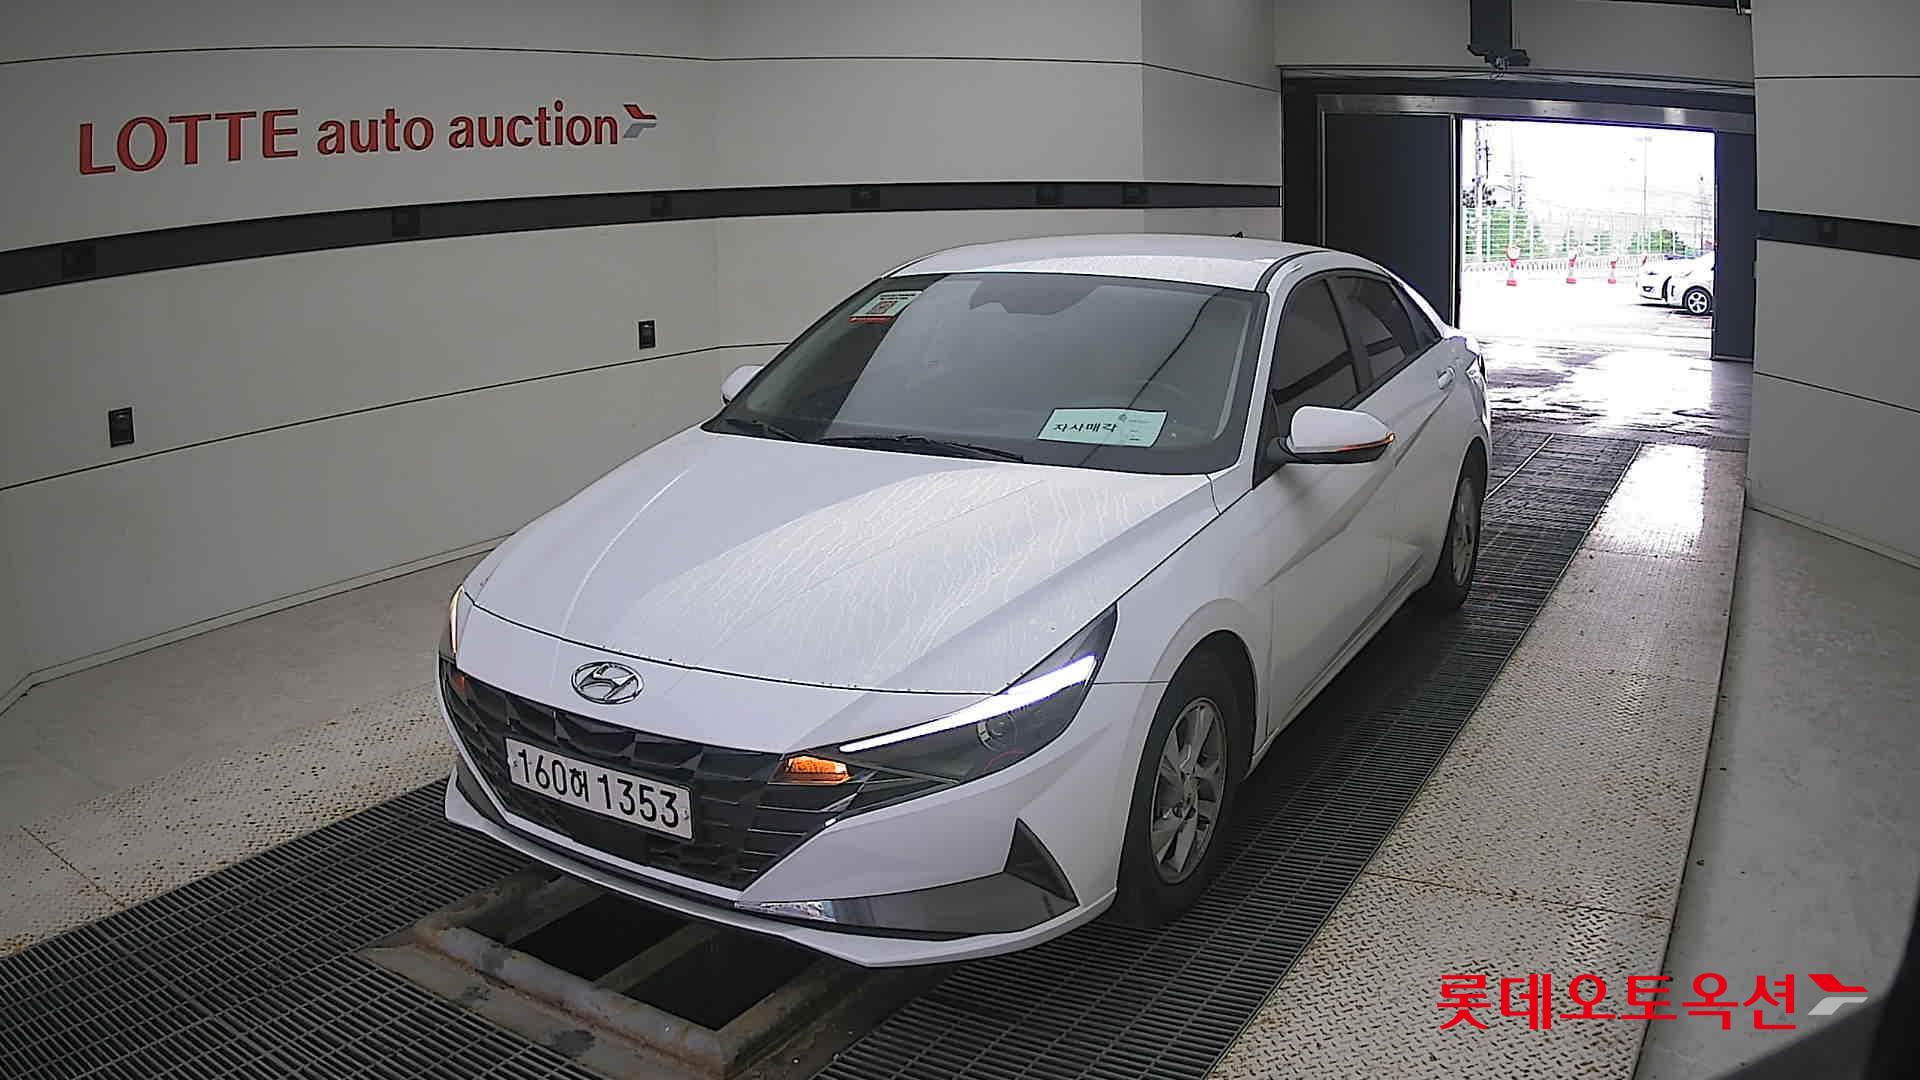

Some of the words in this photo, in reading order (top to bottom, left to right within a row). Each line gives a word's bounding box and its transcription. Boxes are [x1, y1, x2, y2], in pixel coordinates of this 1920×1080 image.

[79, 108, 299, 175] LOTTE
[317, 108, 435, 156] auto
[448, 100, 620, 150] auction
[518, 749, 590, 802] 160허
[597, 773, 679, 828] 1353
